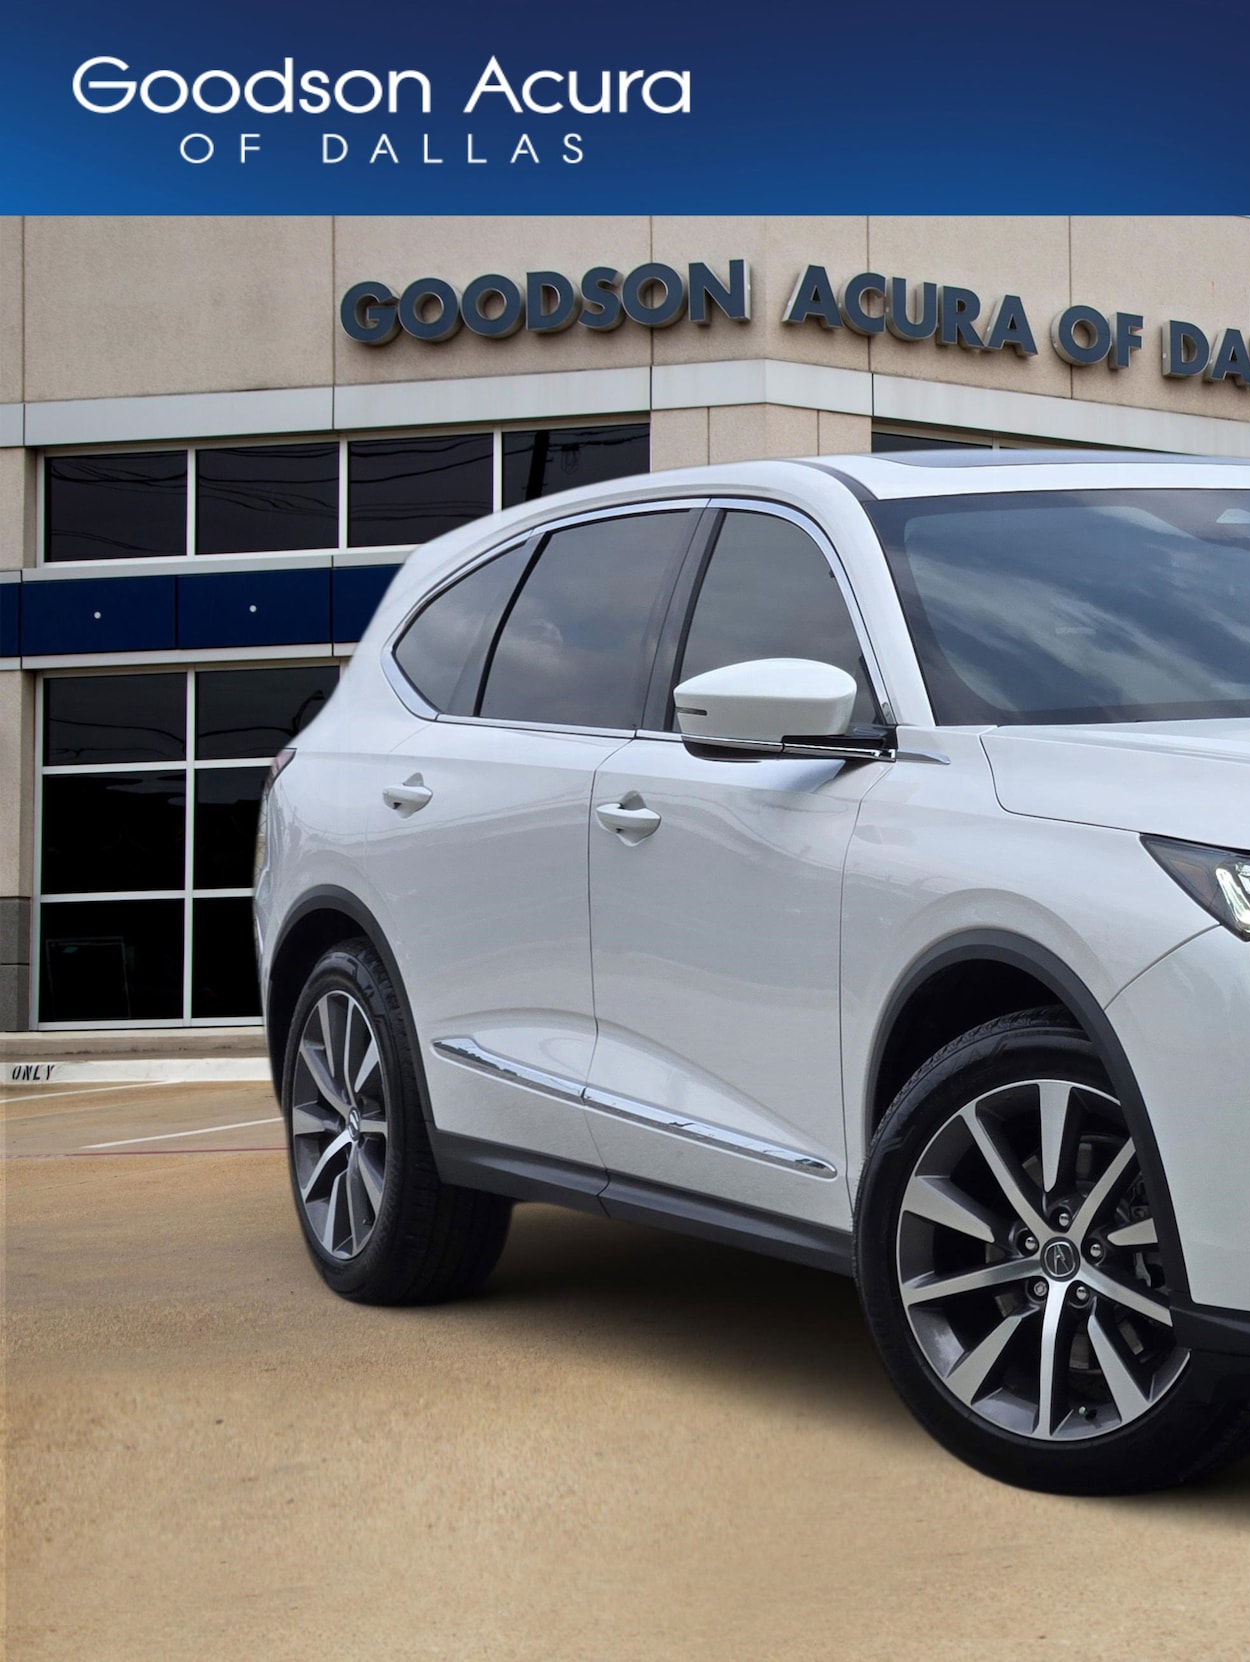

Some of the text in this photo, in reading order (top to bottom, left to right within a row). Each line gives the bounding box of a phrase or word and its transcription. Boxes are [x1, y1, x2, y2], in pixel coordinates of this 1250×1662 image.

[340, 259, 751, 347] GOODSON
[783, 264, 1039, 357] ACURA
[1051, 305, 1143, 369] OF
[12, 1064, 55, 1080] ONLY
